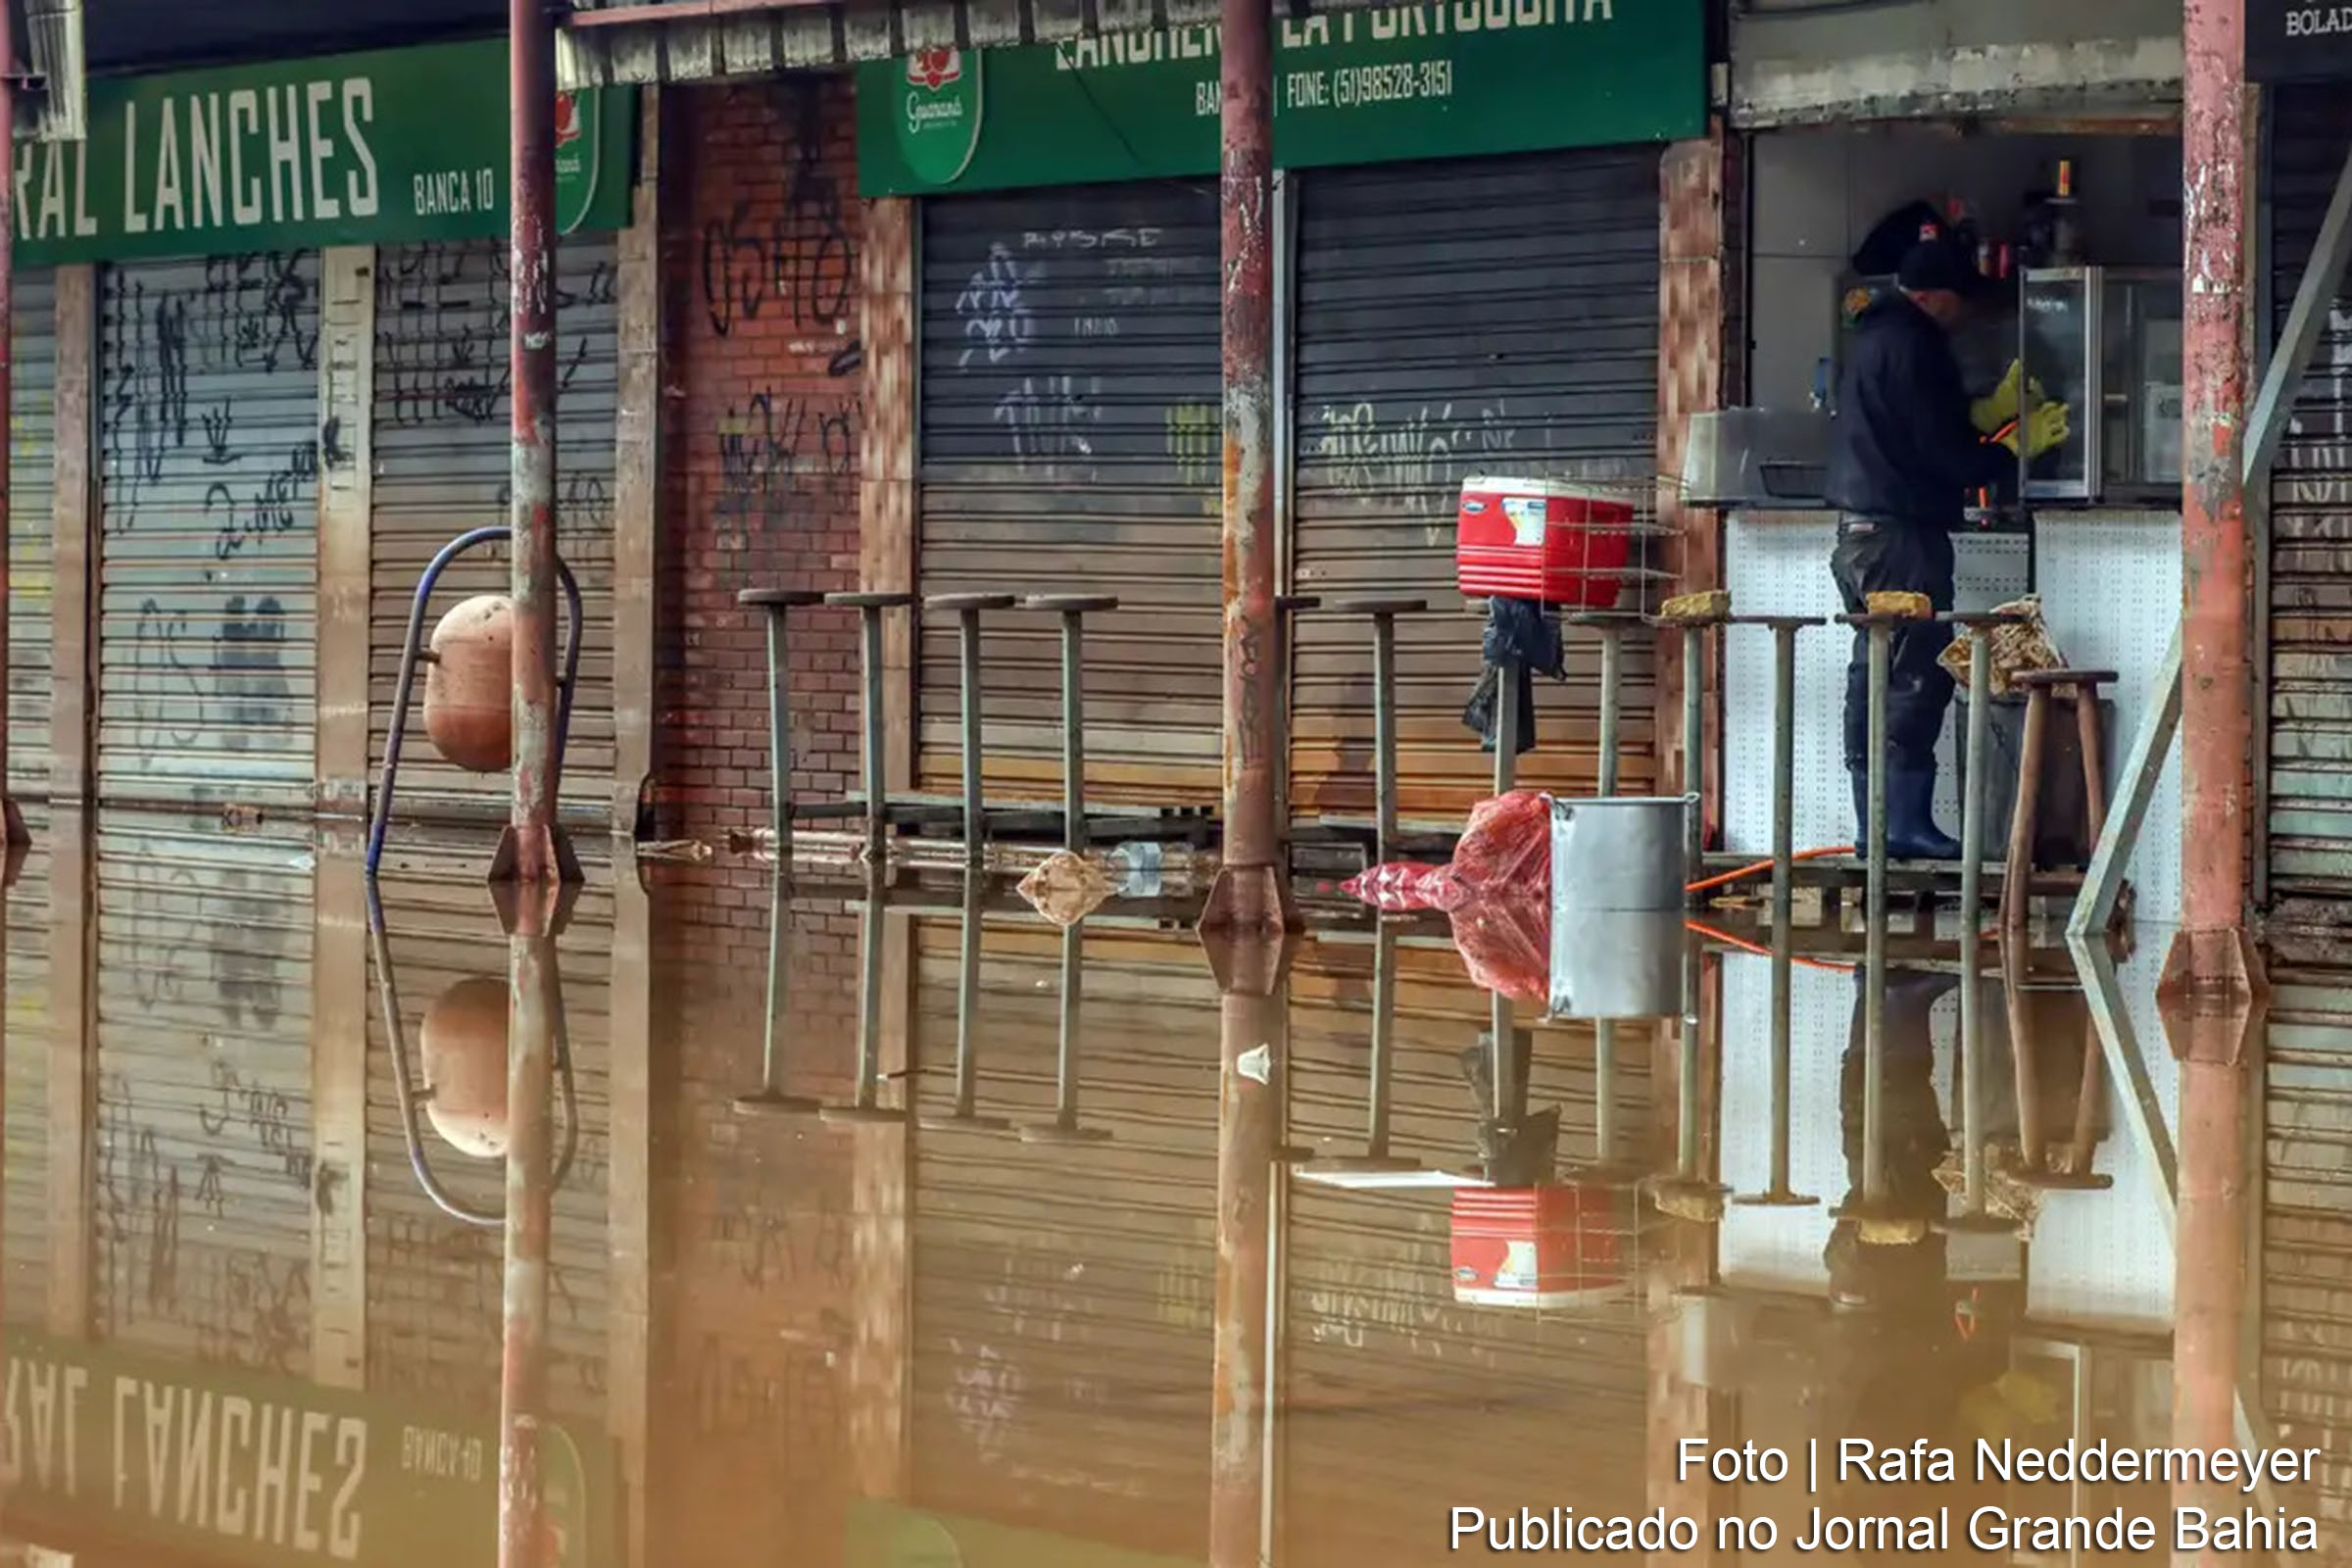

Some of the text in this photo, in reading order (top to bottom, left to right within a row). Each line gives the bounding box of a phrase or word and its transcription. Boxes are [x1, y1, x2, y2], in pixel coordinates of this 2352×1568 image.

[1287, 72, 1330, 109] FONE:
[1333, 60, 1452, 108] (51)98528-3151
[124, 76, 379, 234] LANCHES
[414, 168, 494, 216] BANCA 10
